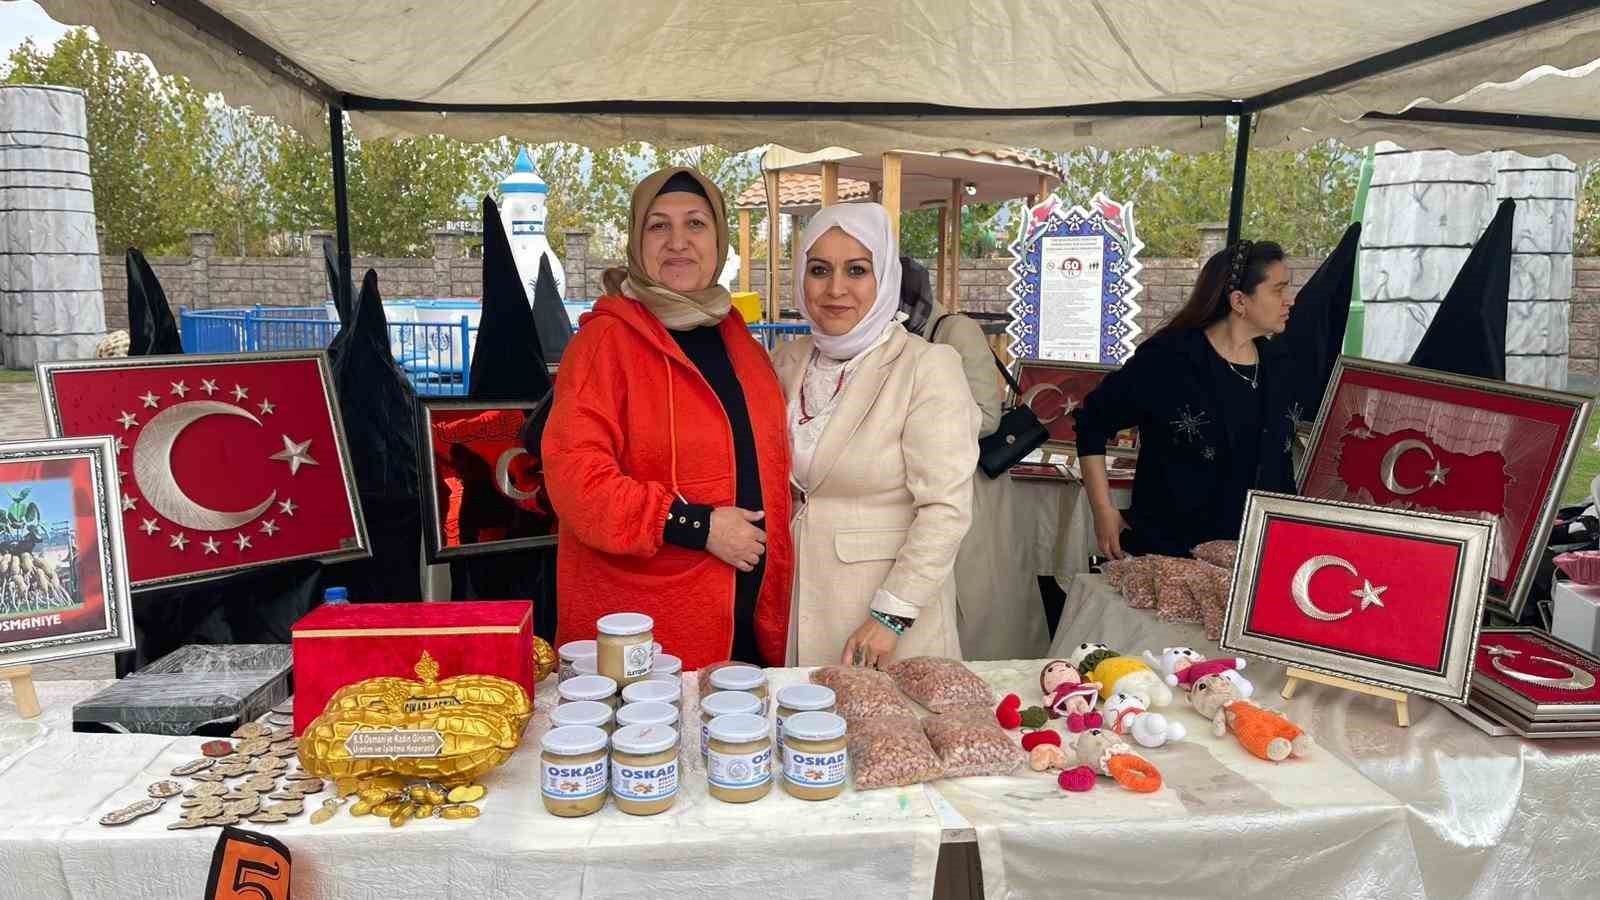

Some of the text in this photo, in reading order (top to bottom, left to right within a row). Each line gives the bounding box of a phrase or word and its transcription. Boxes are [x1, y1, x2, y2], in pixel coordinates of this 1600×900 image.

[1064, 260, 1079, 269] 60
[0, 614, 62, 631] SMANIYE
[793, 754, 845, 767] OSKAD
[548, 763, 604, 778] OSKAD
[621, 765, 676, 779] OSKAD
[232, 857, 281, 900] 5
